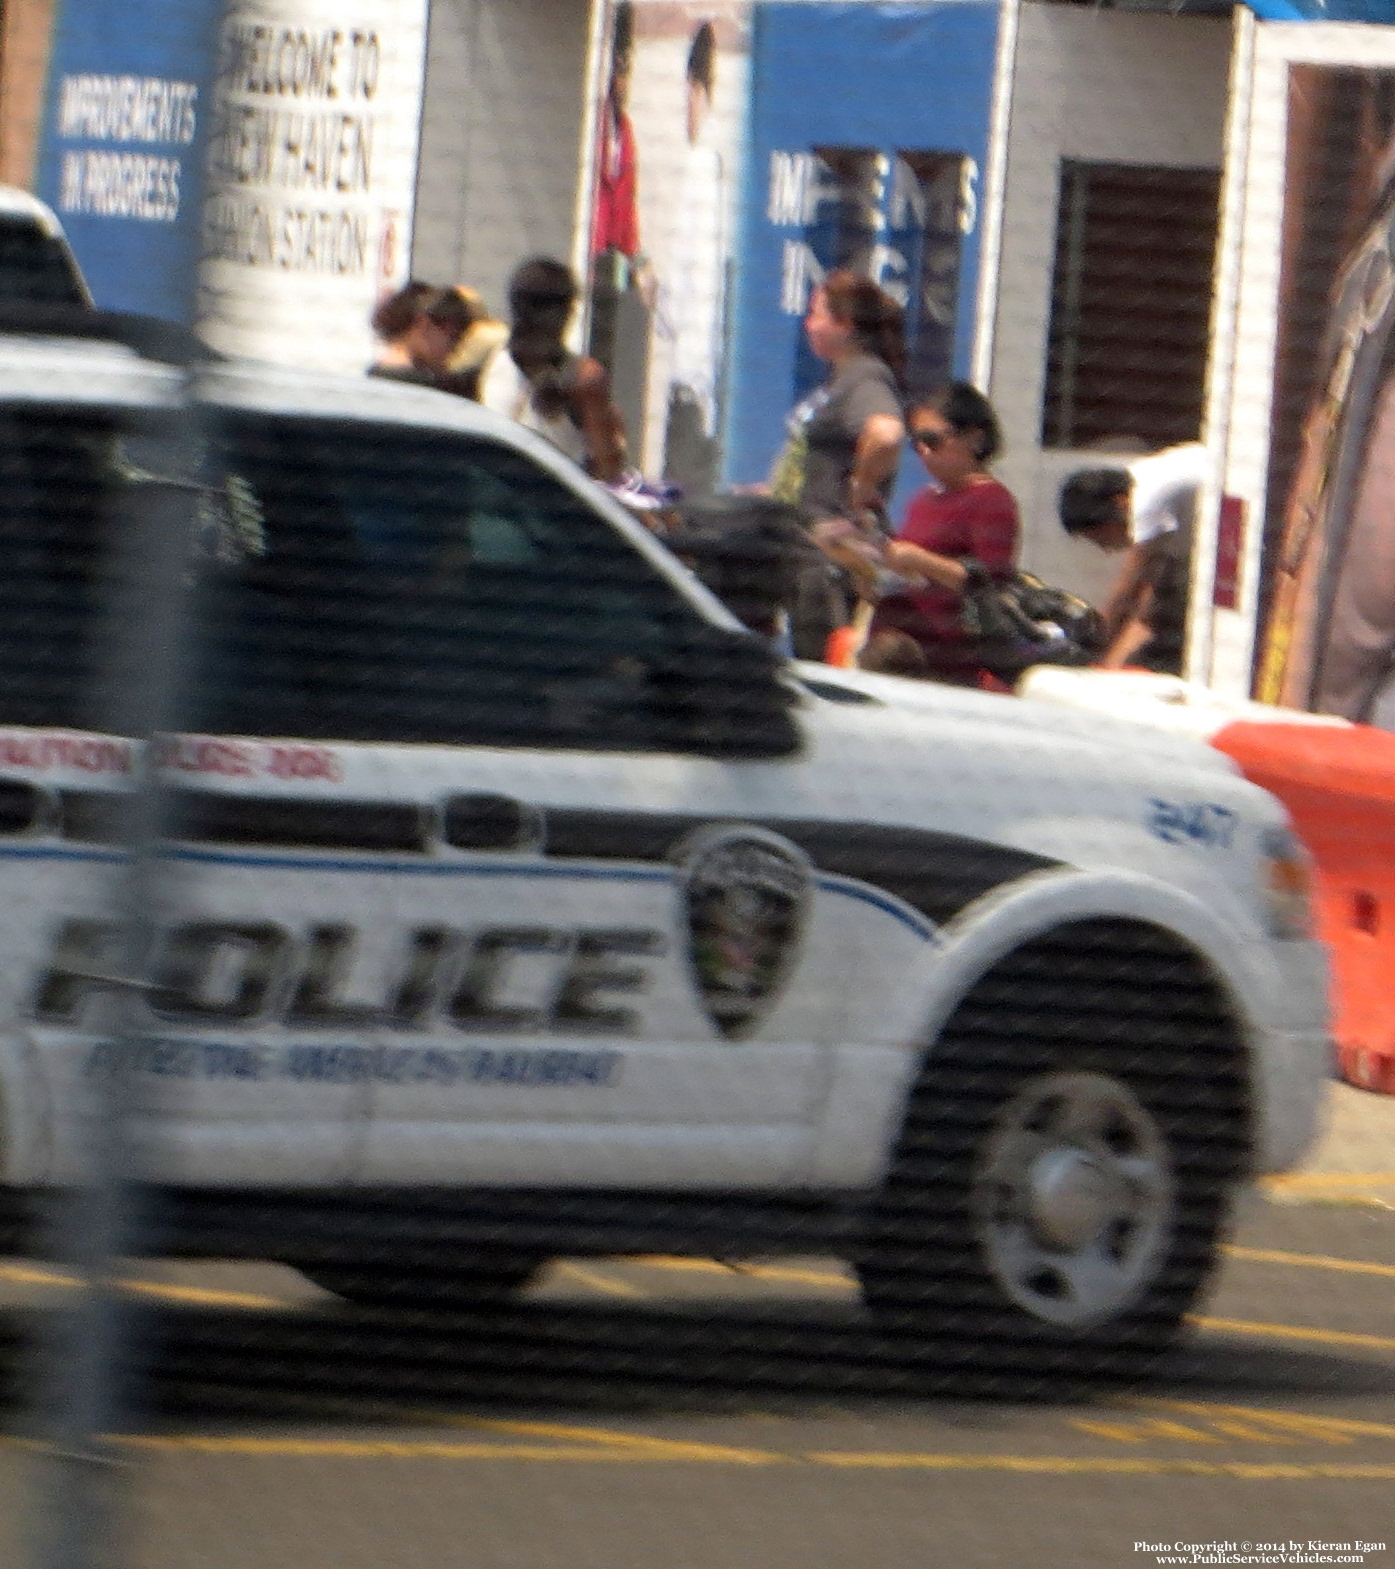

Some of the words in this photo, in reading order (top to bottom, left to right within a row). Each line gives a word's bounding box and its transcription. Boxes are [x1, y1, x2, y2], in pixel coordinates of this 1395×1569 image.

[351, 28, 380, 101] TO
[60, 73, 198, 145] IMPROVEMENTS
[61, 150, 81, 213] IN
[84, 151, 182, 222] PROGRESS
[278, 110, 375, 193] HAVEN
[279, 208, 367, 276] STATION
[147, 736, 259, 780] OLICE
[32, 916, 668, 1033] POLICE
